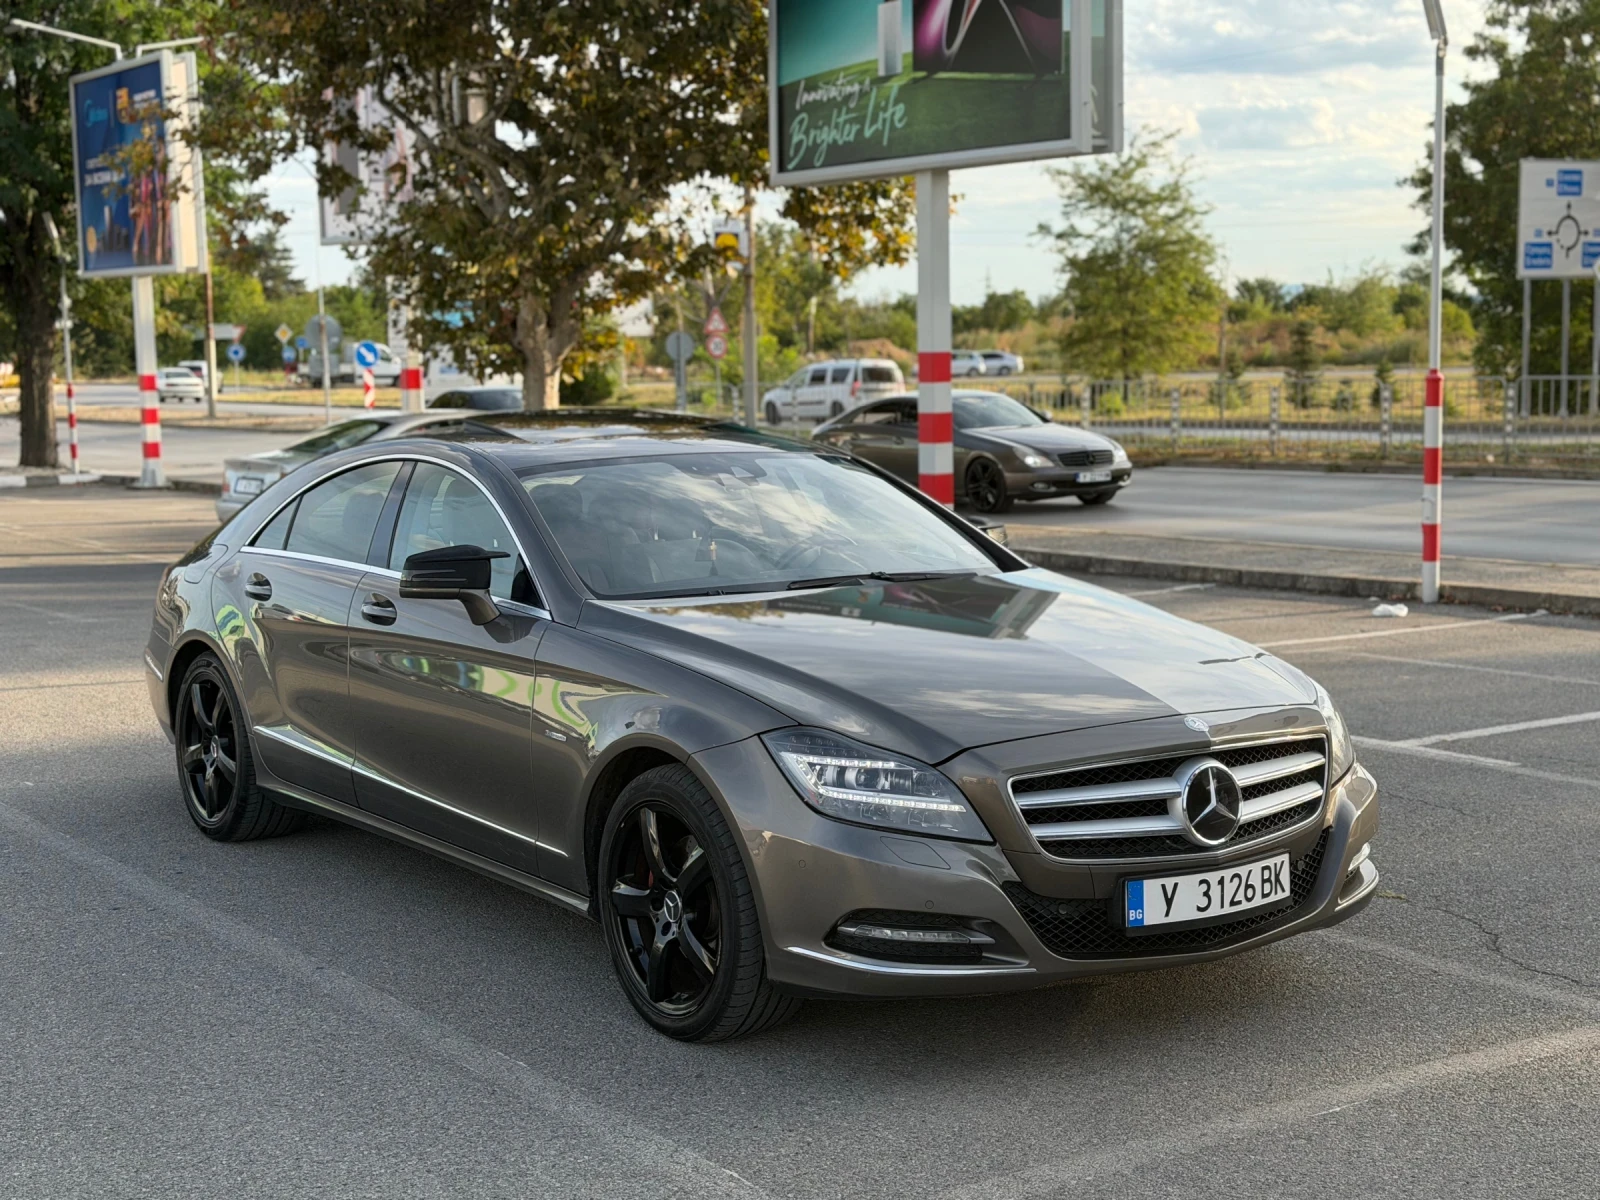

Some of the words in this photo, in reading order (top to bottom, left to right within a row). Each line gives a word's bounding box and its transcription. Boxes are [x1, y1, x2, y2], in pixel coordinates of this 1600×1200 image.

[787, 106, 860, 170] Brighter
[864, 84, 908, 147] Life
[1129, 909, 1143, 920] BG
